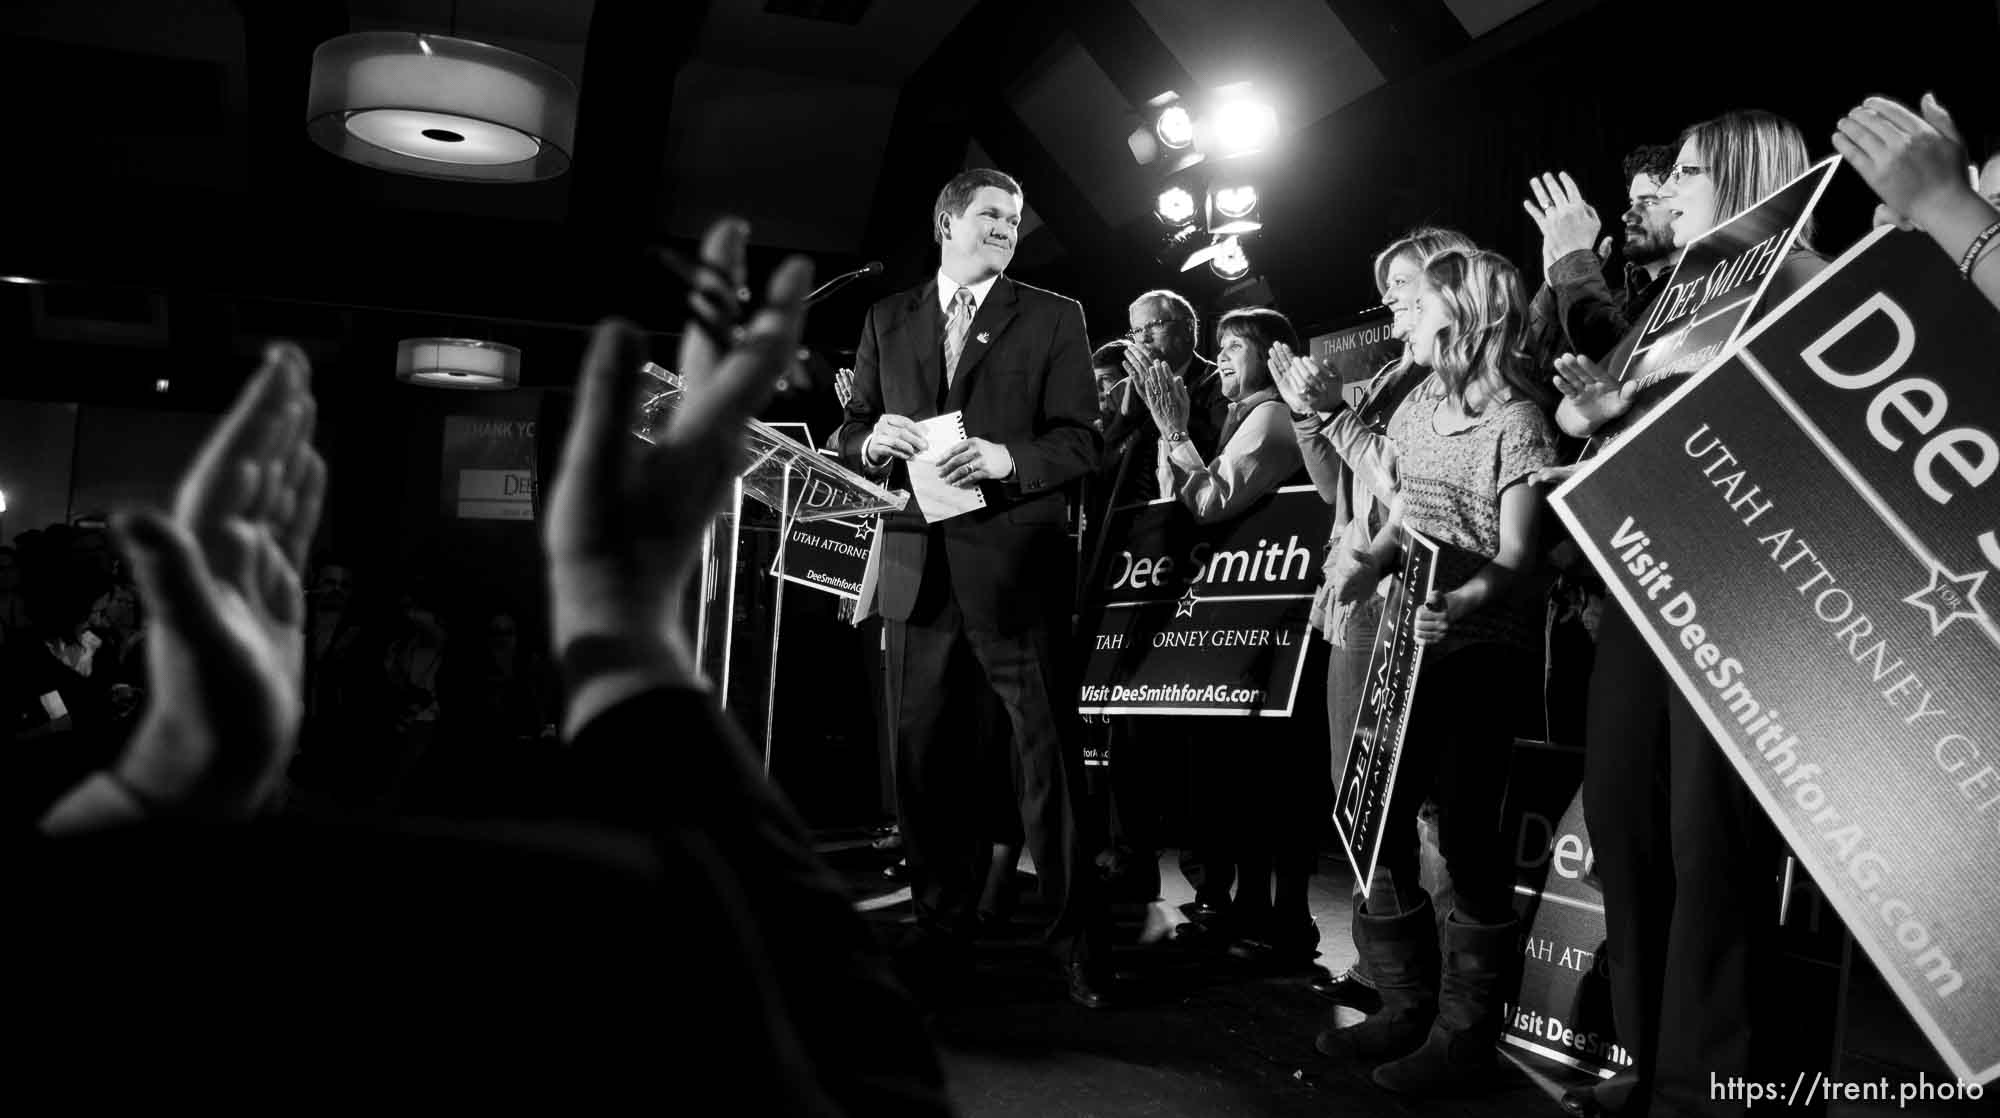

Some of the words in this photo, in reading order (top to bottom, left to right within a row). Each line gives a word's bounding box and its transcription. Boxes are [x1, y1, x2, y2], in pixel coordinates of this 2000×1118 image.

[1648, 276, 1705, 334] DEE
[1690, 227, 1791, 315] SMITH
[1323, 333, 1357, 353] THANK
[1358, 327, 1380, 349] YOU
[1800, 291, 2000, 506] Dee
[792, 530, 821, 548] UTAH
[821, 539, 870, 560] ATTORNE
[1105, 551, 1175, 590] Dee
[1182, 535, 1311, 585] Smith
[1684, 424, 1774, 526] UTAH
[1758, 528, 1946, 726] ATTORNEY
[1096, 633, 1124, 650] TAH
[1080, 684, 1110, 702] Visit
[1344, 727, 1373, 832] DEE
[1610, 516, 1674, 601] Visit
[1658, 591, 1965, 1001] DeeSmithforAG.com
[1523, 936, 1554, 963] AH
[1503, 1001, 1544, 1037] Visit
